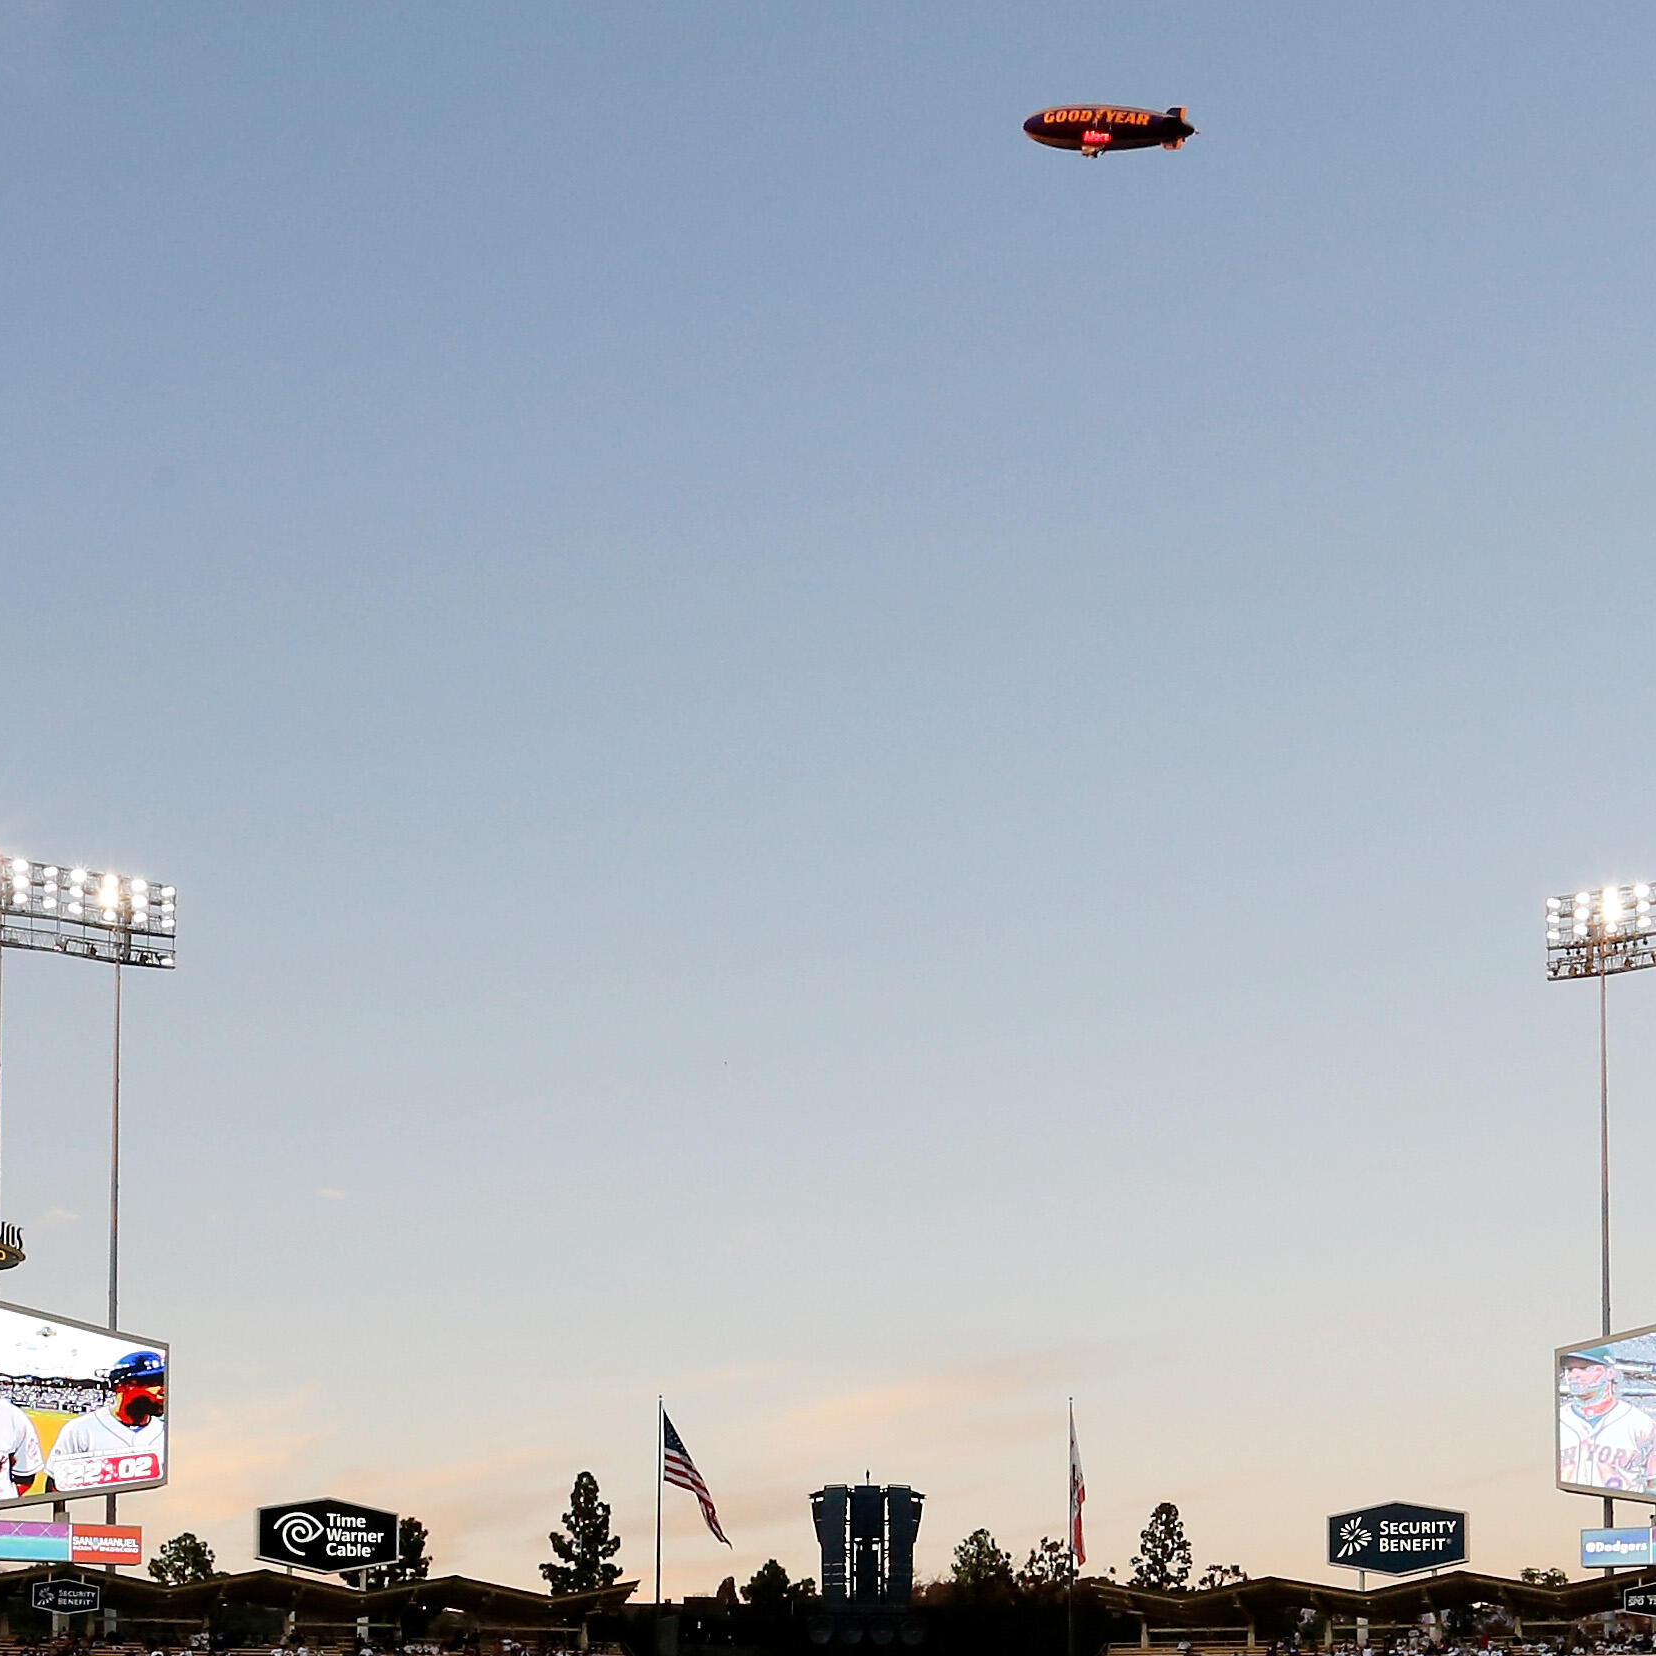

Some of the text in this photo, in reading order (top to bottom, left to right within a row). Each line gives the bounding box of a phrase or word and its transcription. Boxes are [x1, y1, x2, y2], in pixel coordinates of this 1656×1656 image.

[326, 1512, 367, 1528] Time
[1379, 1520, 1457, 1536] SECURITY
[325, 1527, 385, 1543] Warner
[325, 1542, 372, 1558] Cable
[1379, 1537, 1447, 1553] BENEFIT
[1585, 1540, 1648, 1555] @Dodgers
[57, 1589, 96, 1598] SECURITY
[57, 1597, 93, 1606] BENEFIT
